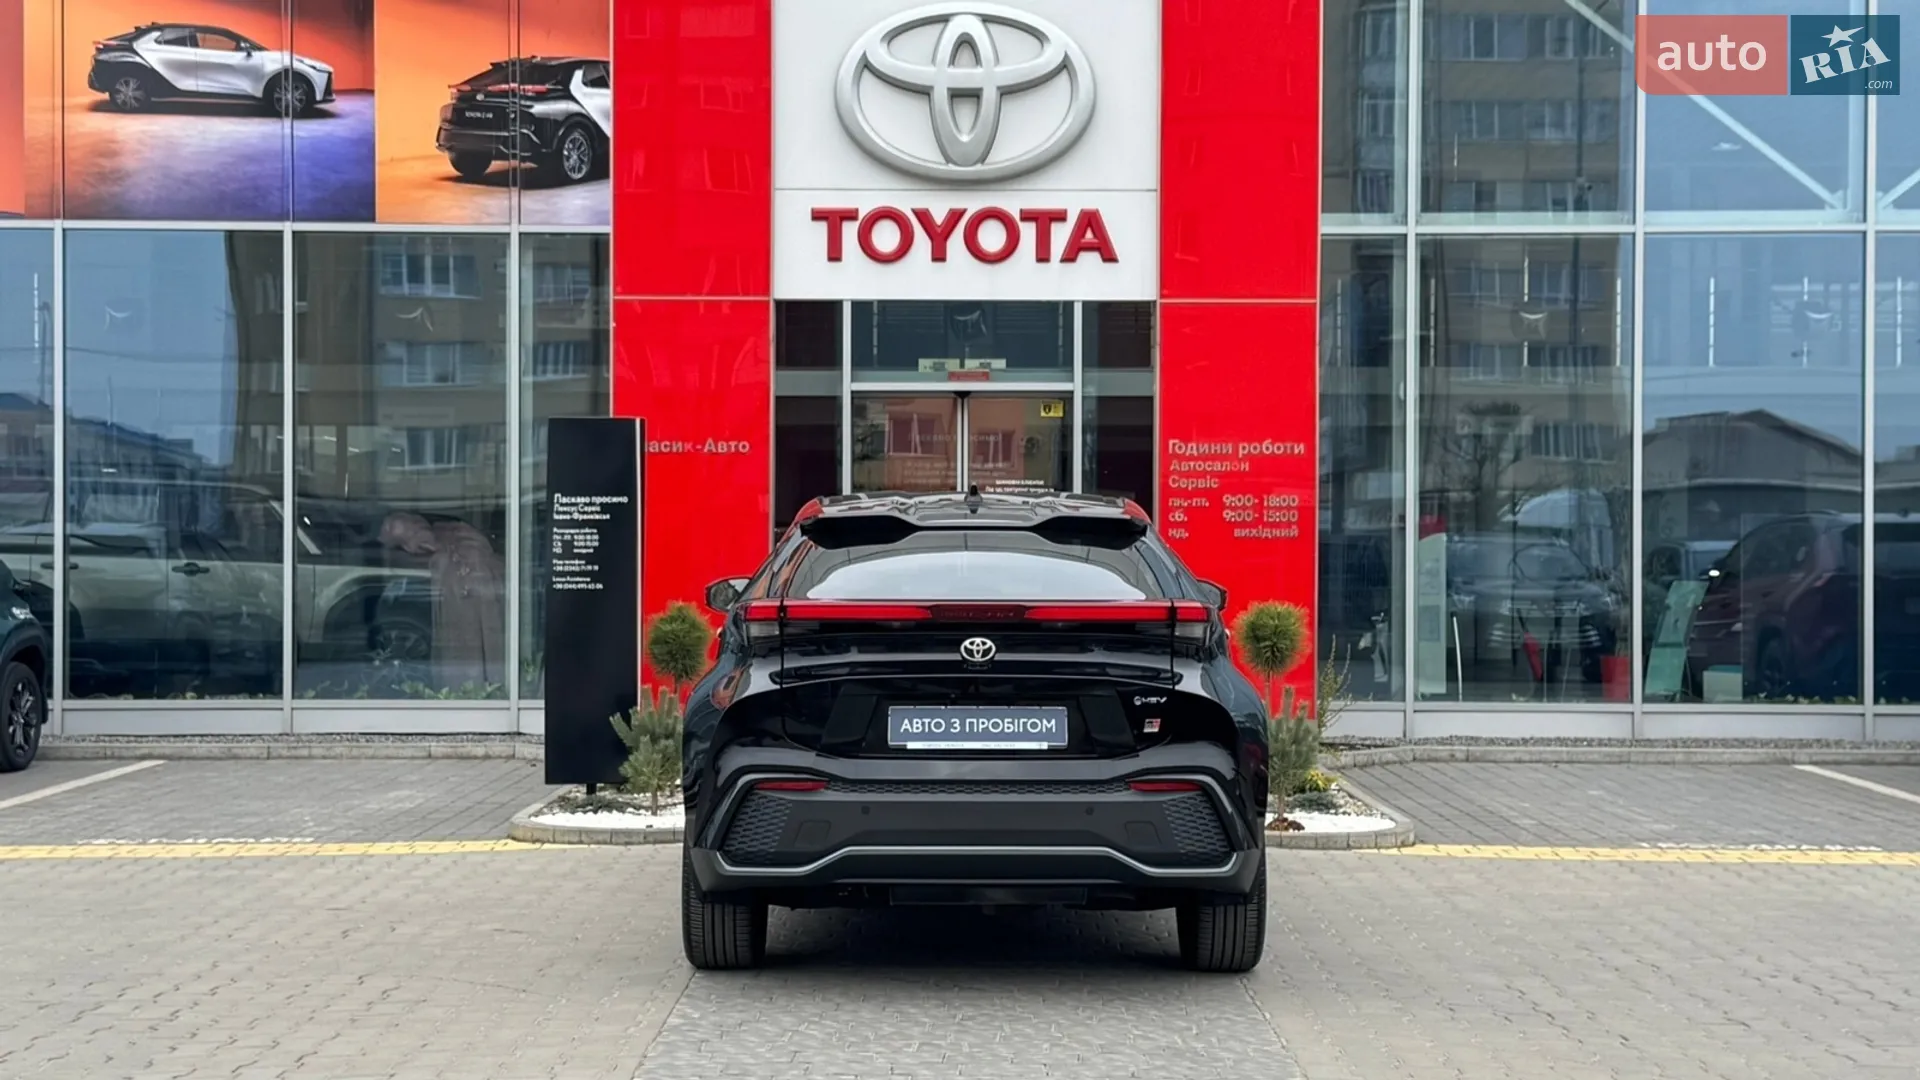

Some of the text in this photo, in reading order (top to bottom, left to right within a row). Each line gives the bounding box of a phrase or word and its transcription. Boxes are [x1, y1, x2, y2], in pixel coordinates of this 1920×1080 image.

[811, 206, 1119, 264] TOYOTA
[644, 437, 750, 453] асик-Авто
[1168, 438, 1305, 458] Години роботи
[1169, 460, 1249, 471] Автосалон
[1168, 475, 1219, 490] Сервіс
[1168, 509, 1188, 521] сб.
[1168, 525, 1298, 538] нд. вихідний
[900, 718, 1056, 733] АВТО З ПРОБІГОМ
